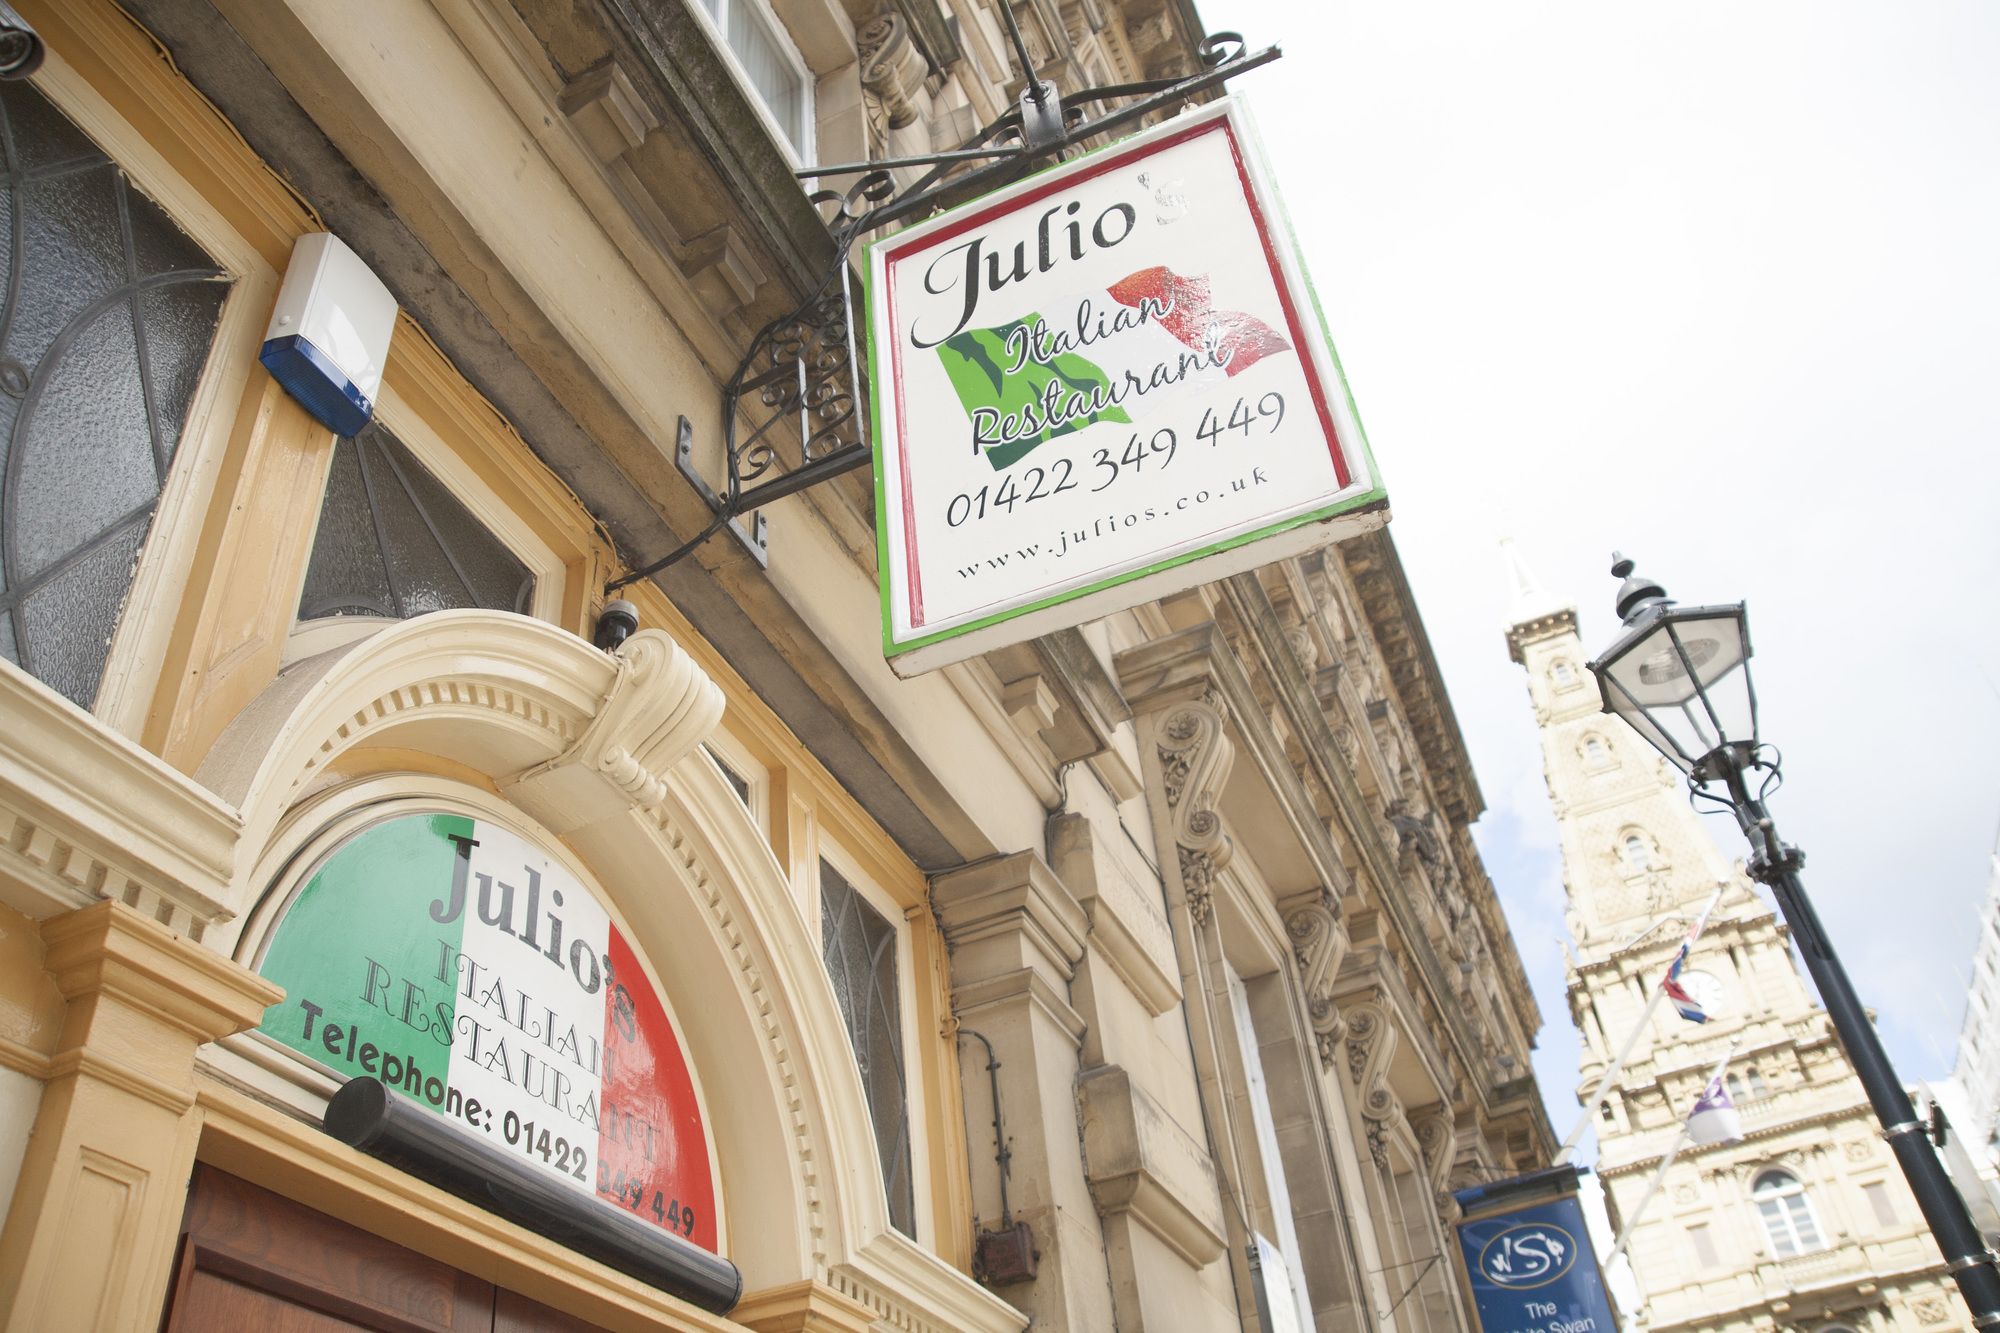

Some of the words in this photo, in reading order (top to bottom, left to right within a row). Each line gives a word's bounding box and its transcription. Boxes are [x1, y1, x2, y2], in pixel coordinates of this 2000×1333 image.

[971, 329, 1233, 455] Restaurant
[1005, 297, 1172, 374] Italian
[946, 458, 1079, 527] 01422
[1091, 428, 1178, 493] 349
[1196, 391, 1286, 448] 449
[957, 467, 1268, 579] www.julios.co.uk
[429, 833, 636, 1043] Julio's
[359, 955, 661, 1165] RESTAURANT
[432, 938, 617, 1086] ITALIAN
[299, 999, 494, 1134] Telephone:
[503, 1110, 588, 1183] 01422
[596, 1158, 643, 1211] 349
[652, 1191, 695, 1238] 449
[1524, 1302, 1557, 1319] The
[1549, 1317, 1596, 1333] Swan
